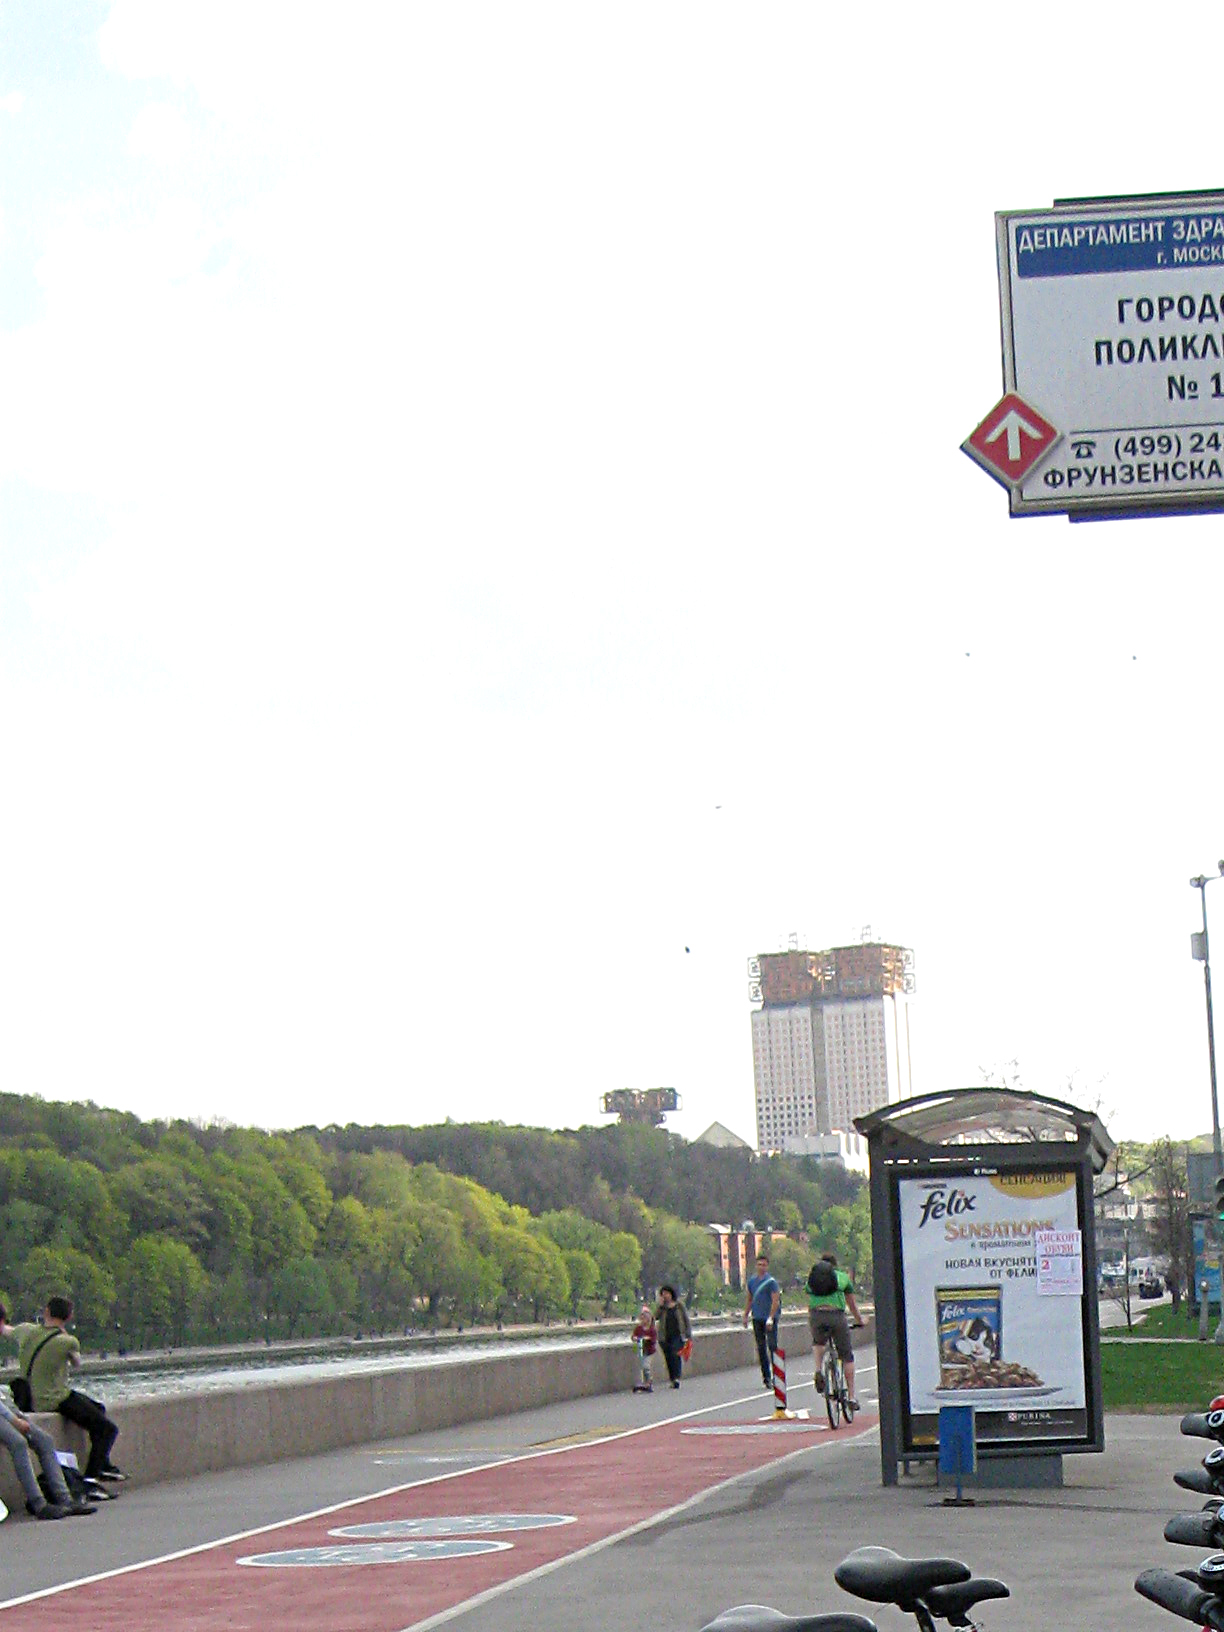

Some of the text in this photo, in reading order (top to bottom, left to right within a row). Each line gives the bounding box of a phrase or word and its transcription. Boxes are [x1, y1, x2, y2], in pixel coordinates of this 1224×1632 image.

[1019, 220, 1165, 253] ДЕПАРТАМЕНТ
[1157, 252, 1168, 265] г.
[1167, 374, 1199, 400] №
[1114, 434, 1182, 459] (499)
[919, 1189, 977, 1229] felix
[945, 1258, 982, 1269] НОВАЯ
[990, 1267, 1037, 1279] ОТ ФЕЛИ
